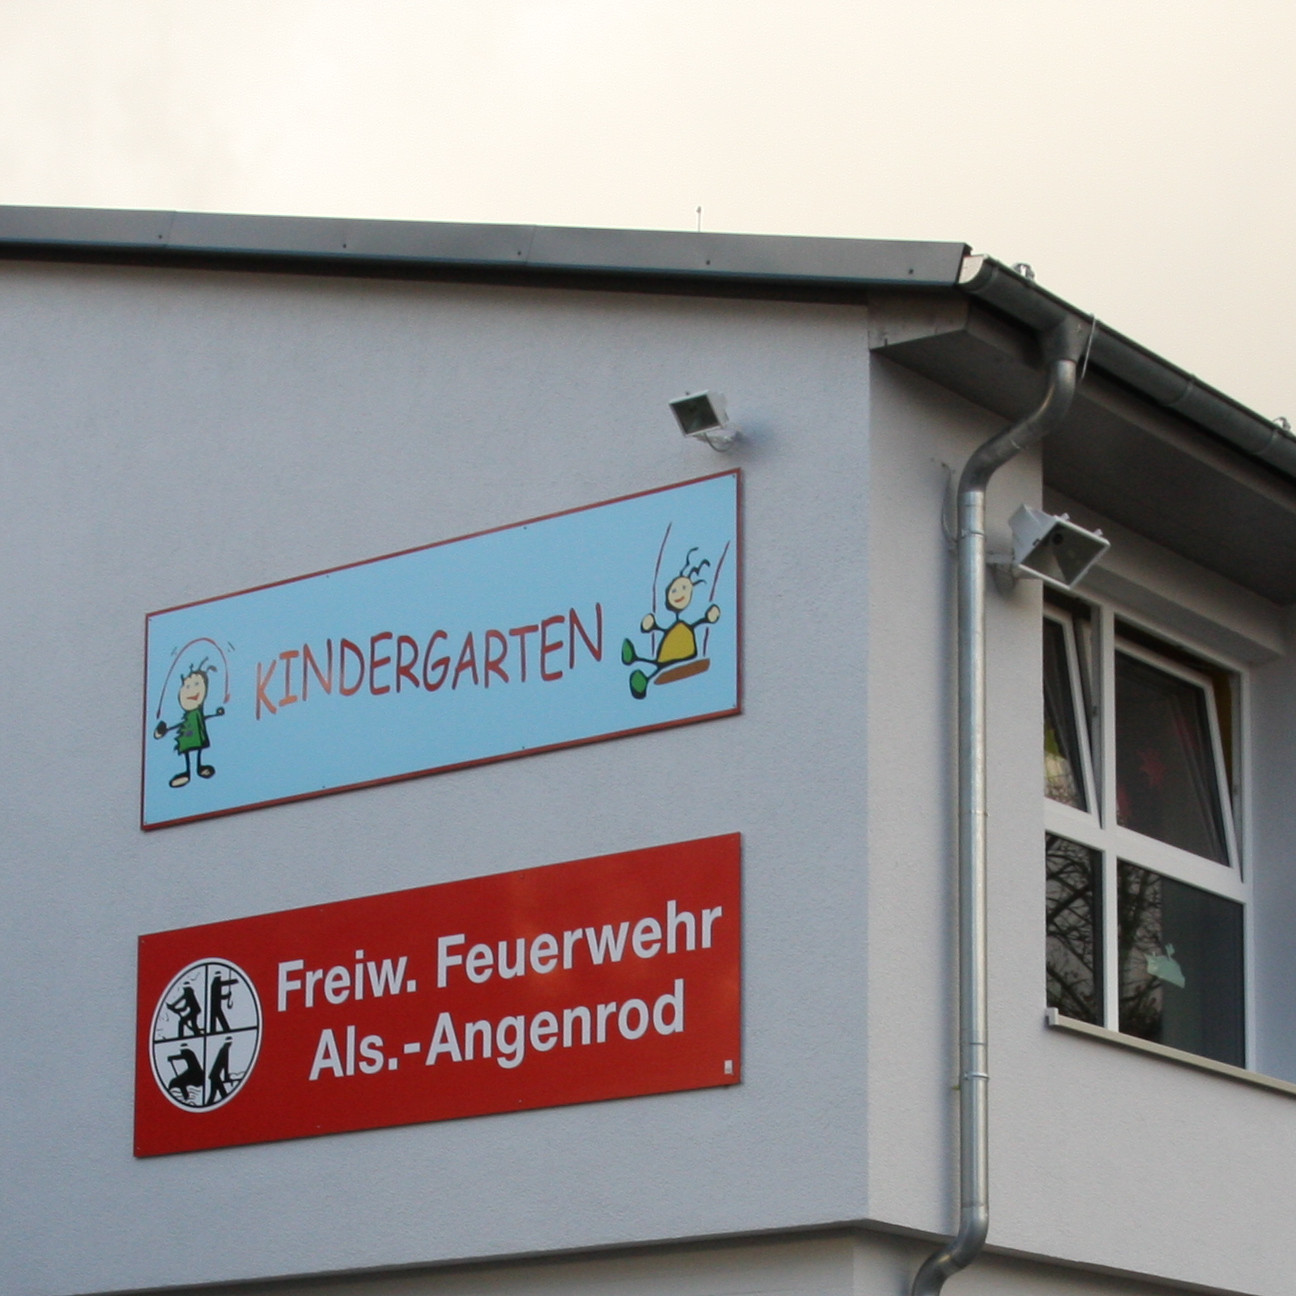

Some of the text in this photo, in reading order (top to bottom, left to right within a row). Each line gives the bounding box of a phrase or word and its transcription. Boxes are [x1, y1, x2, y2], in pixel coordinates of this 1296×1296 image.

[255, 602, 603, 720] KINDERGARTEN
[277, 899, 723, 1012] Freiw. Feuerwehr
[309, 978, 685, 1081] Als.-Angenrod
